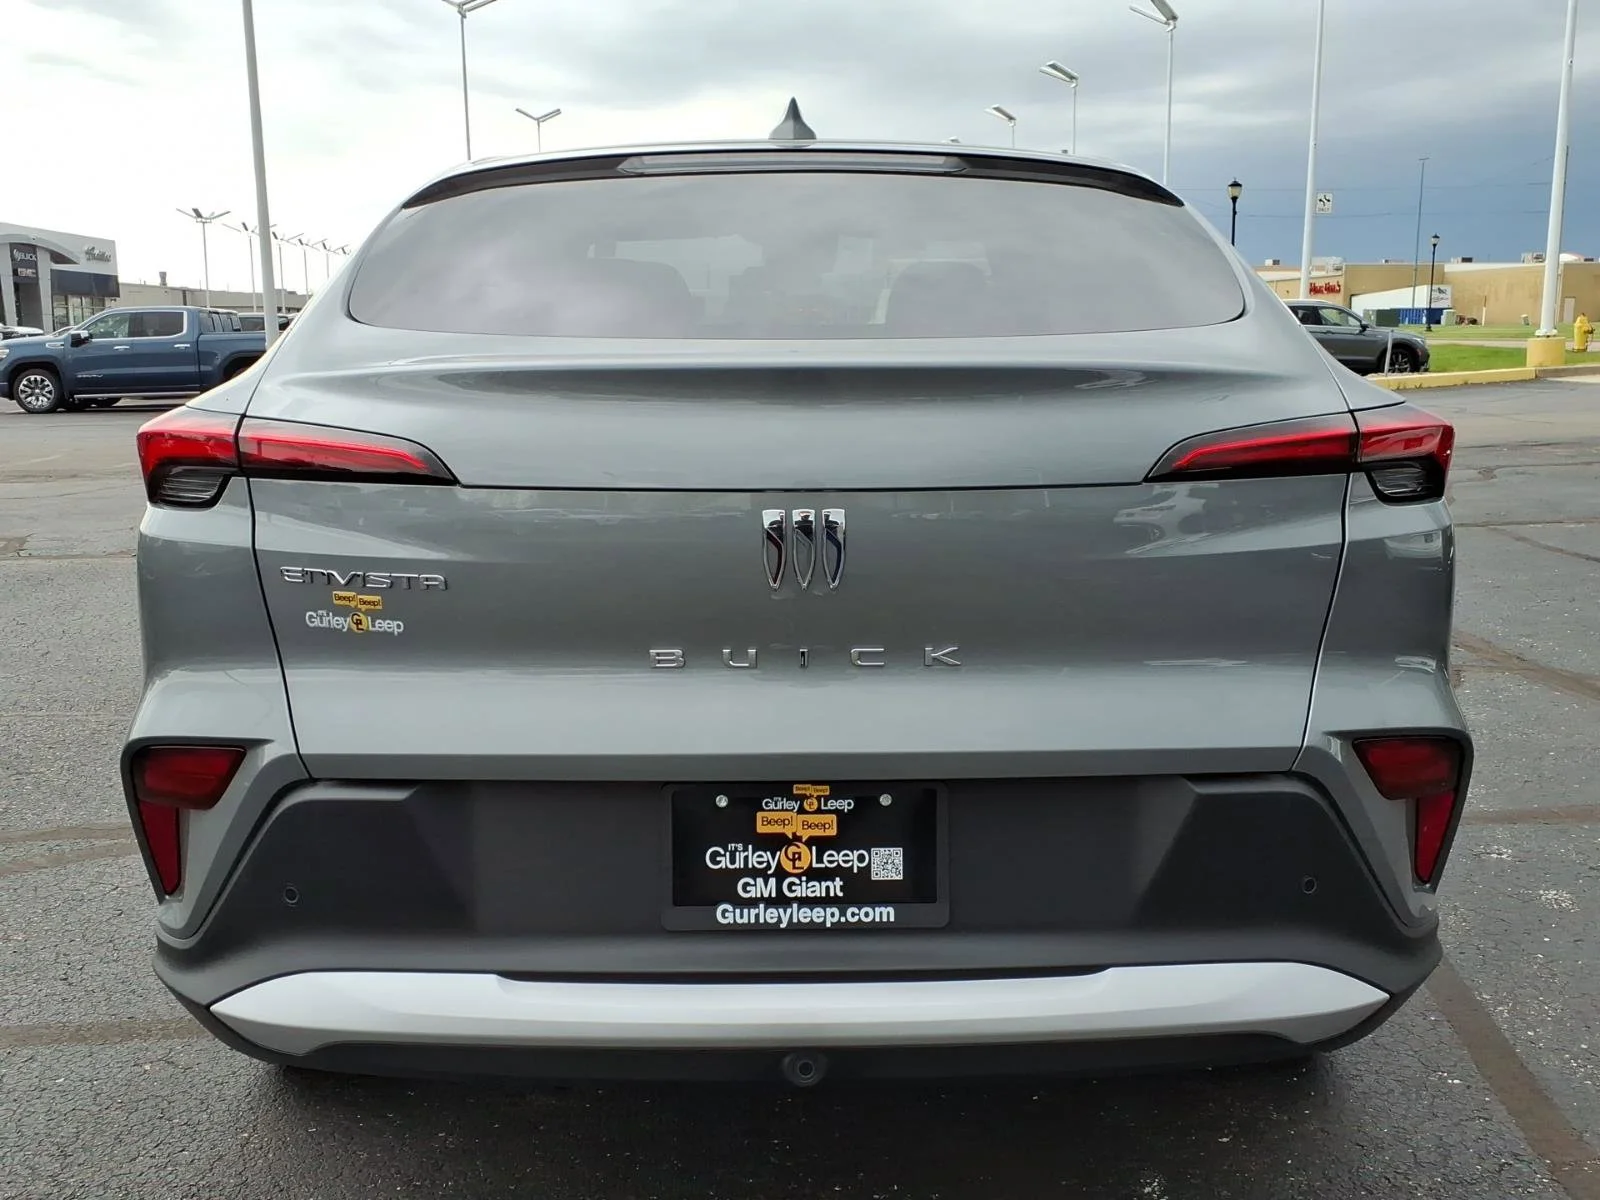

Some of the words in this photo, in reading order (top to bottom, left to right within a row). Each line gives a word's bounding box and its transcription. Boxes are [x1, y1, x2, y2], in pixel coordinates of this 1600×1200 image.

[280, 566, 448, 590] ENVISTA
[334, 593, 356, 603] Beep!
[359, 597, 381, 607] Beep!
[305, 611, 350, 632] Gurley
[367, 616, 404, 636] Leep
[649, 646, 961, 668] BUICK
[762, 797, 800, 813] Gurley
[821, 797, 854, 813] Leep
[761, 816, 793, 829] Beep!
[801, 820, 834, 833] Beep!
[728, 843, 743, 851] IT'S
[705, 845, 780, 875] Gurley
[812, 846, 869, 873] Leep
[737, 877, 776, 898] GM
[782, 876, 844, 898] Giant
[716, 903, 895, 928] Gurleyleep.com
